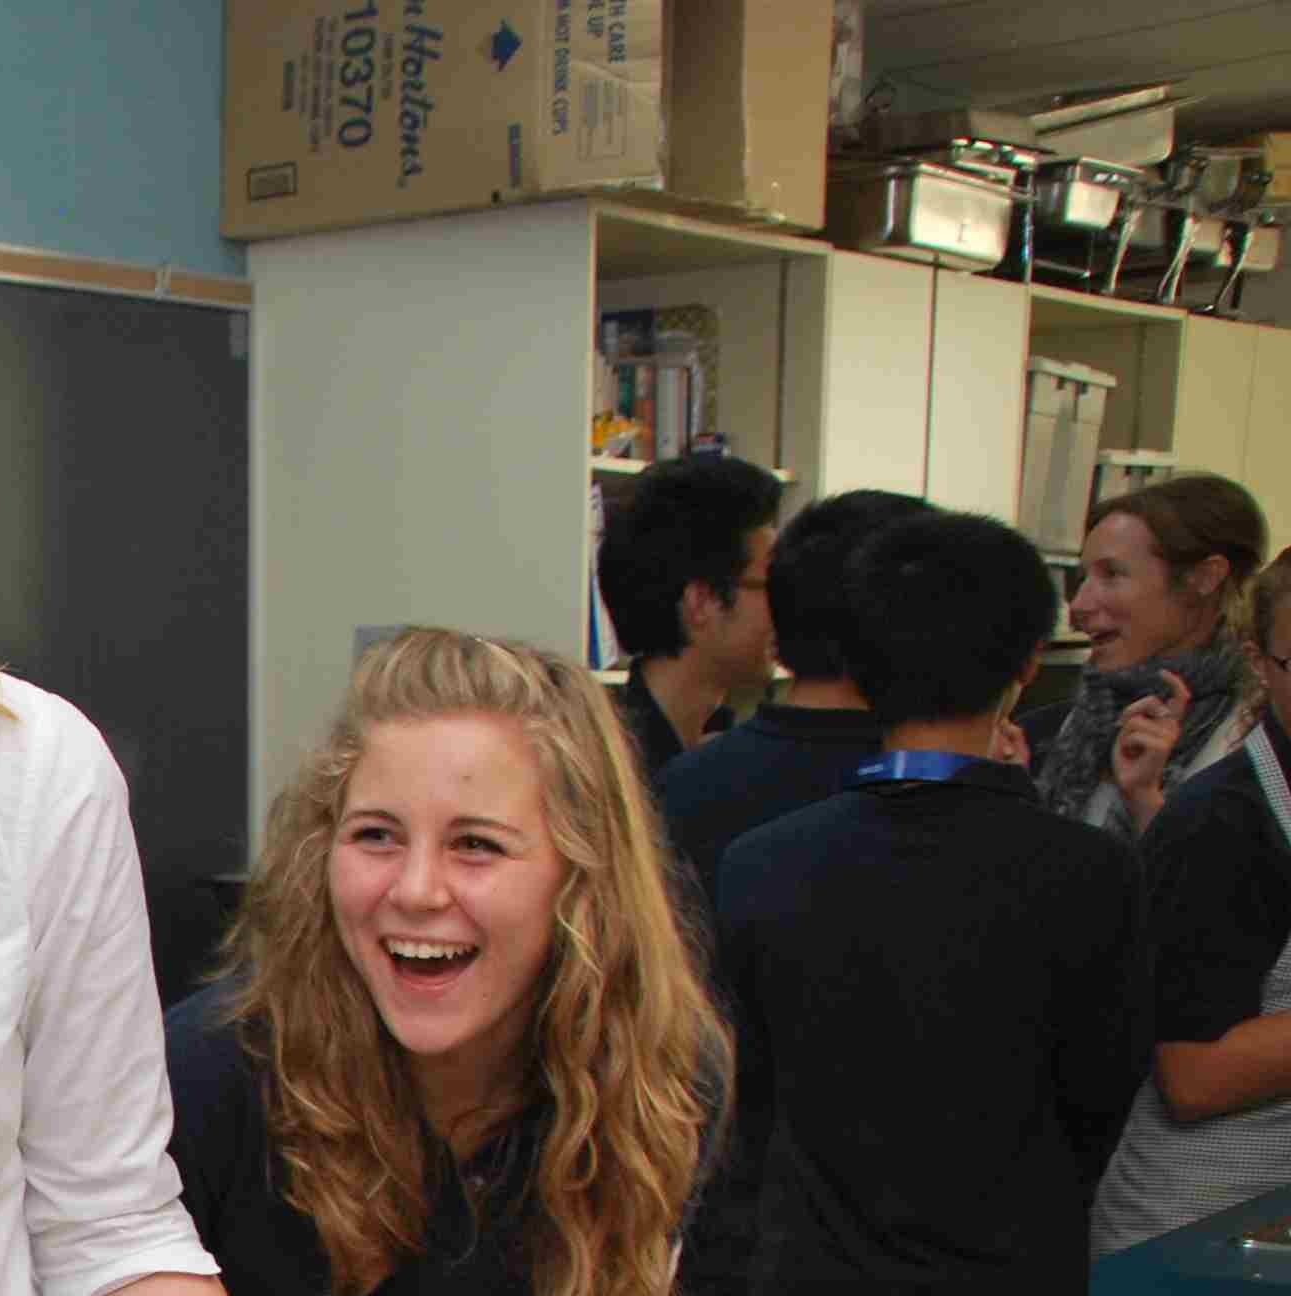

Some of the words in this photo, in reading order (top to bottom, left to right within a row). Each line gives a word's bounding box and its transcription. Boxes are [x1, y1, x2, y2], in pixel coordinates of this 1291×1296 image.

[608, 22, 626, 64] CARE
[337, 0, 379, 148] 10370
[551, 97, 570, 136] CUPS
